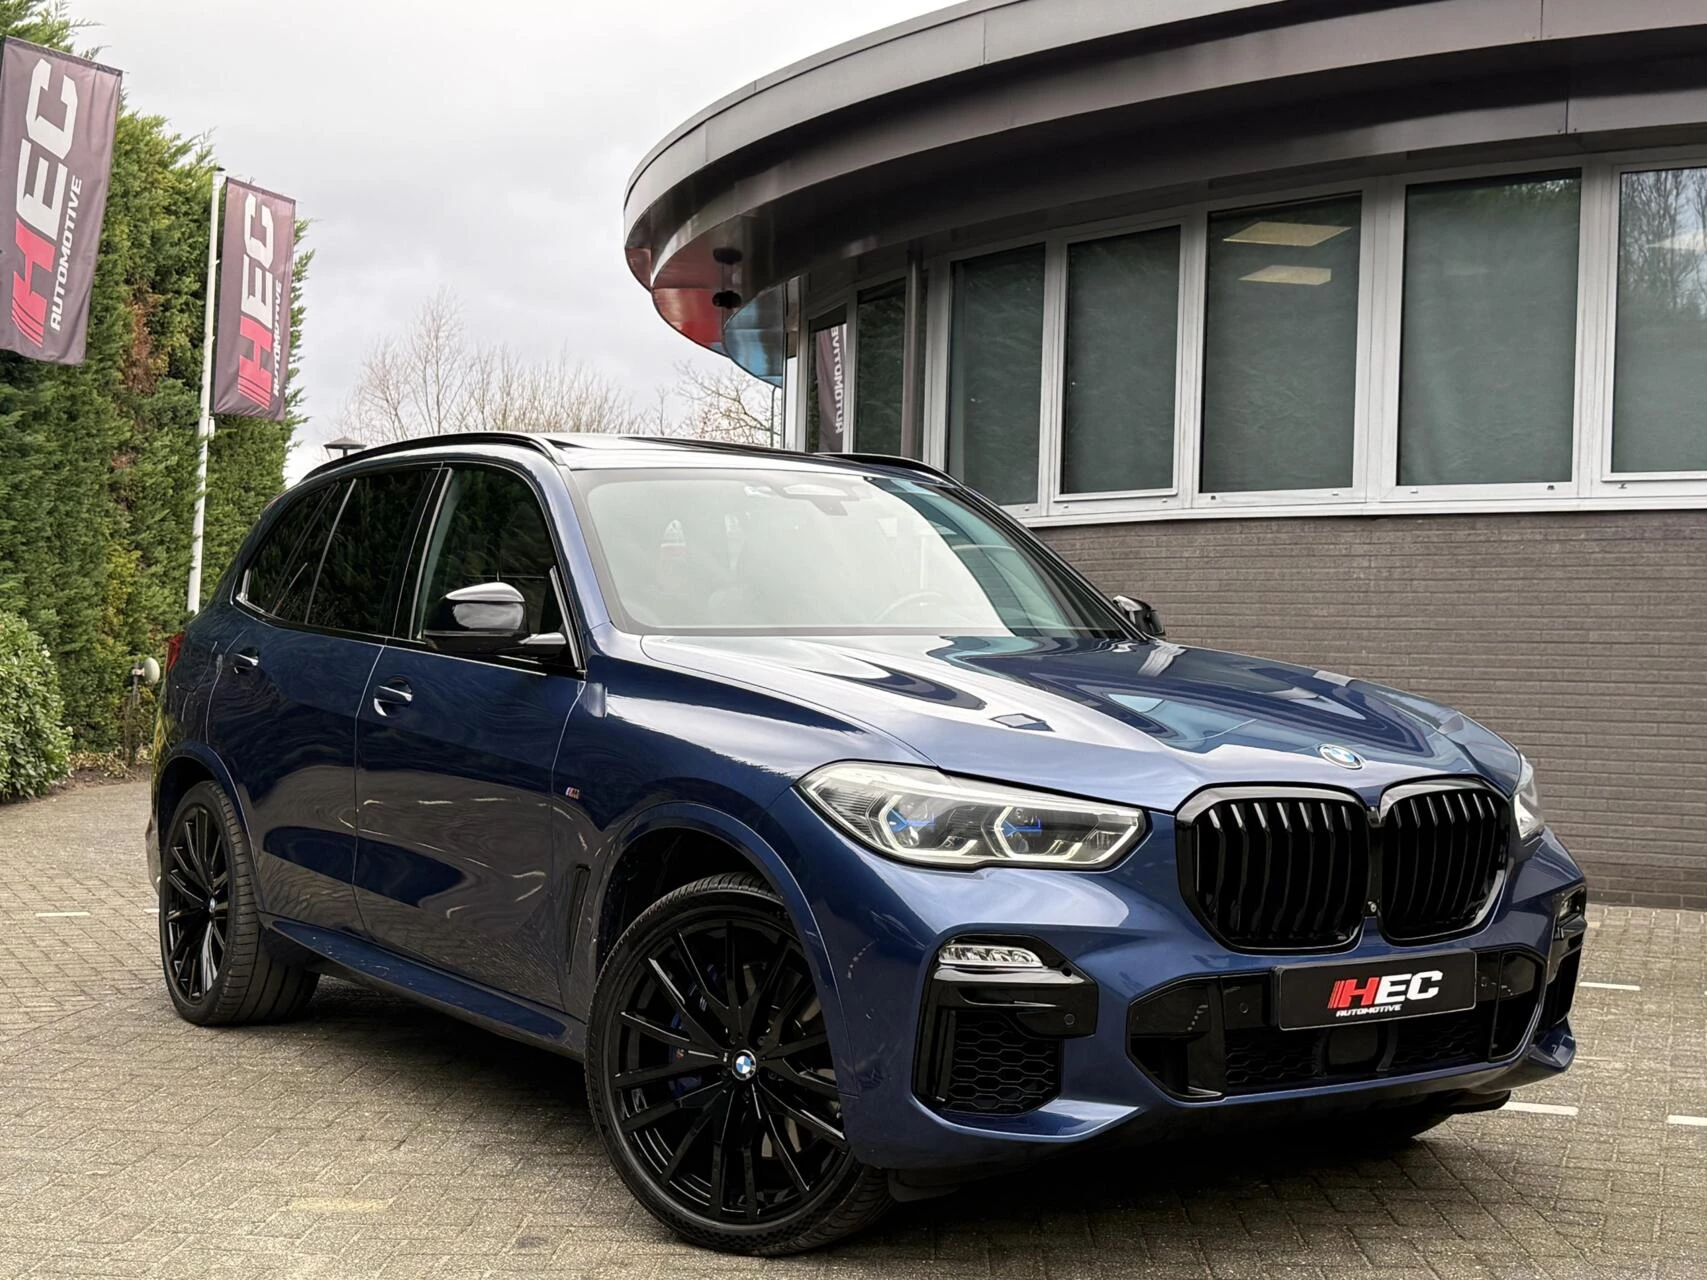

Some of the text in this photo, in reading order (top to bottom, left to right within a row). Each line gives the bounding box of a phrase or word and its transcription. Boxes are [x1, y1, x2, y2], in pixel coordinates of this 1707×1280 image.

[11, 58, 78, 348] HEC
[50, 175, 82, 331] AUTOMOTIVE
[238, 193, 274, 409] HEC
[1329, 970, 1443, 1009] HEC
[1336, 1004, 1402, 1017] AUTOMOTIVE
